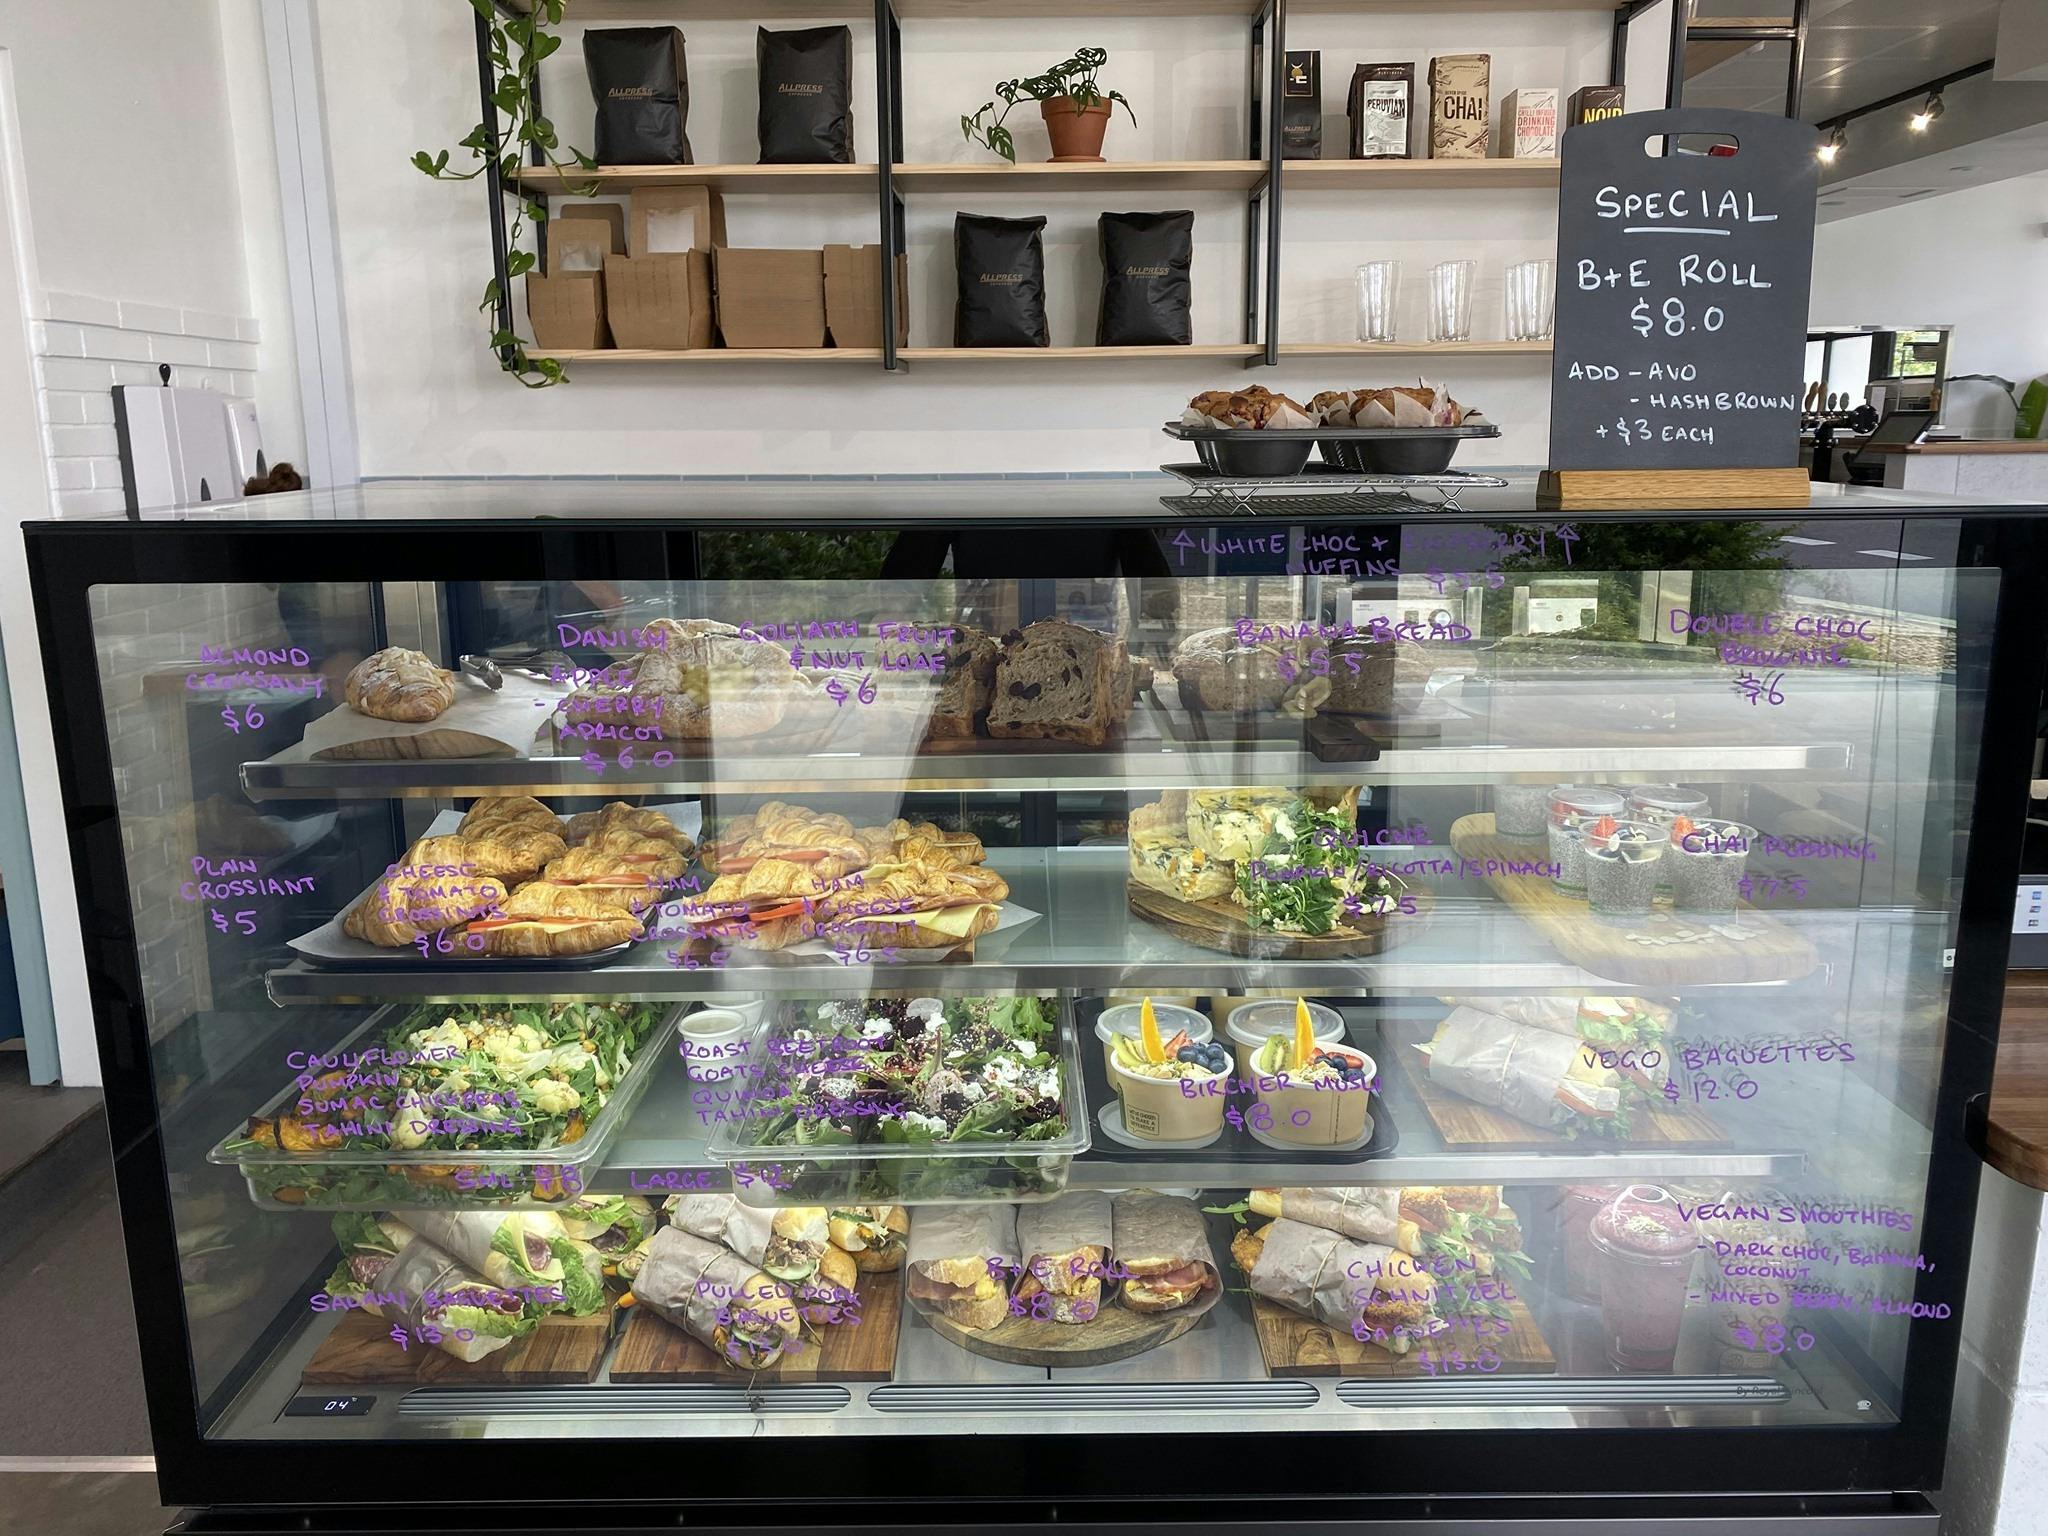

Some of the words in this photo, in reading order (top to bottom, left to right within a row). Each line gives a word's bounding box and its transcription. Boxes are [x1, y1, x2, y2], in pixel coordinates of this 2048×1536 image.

[608, 87, 654, 97] ALLPRESS
[778, 83, 823, 94] ALLPRESS
[1367, 98, 1405, 118] PERUVIAN
[1444, 96, 1483, 120] CHAI
[1517, 117, 1556, 126] DRINKING
[1517, 126, 1555, 137] CHOCOLATE
[1595, 186, 1778, 222] SPECIAL
[1577, 259, 1651, 290] B+E
[1679, 254, 1772, 288] ROLL
[1630, 297, 1725, 337] $8.0
[1568, 362, 1620, 380] ADD
[1648, 362, 1697, 381] AVO
[1616, 417, 1652, 445] $3
[1661, 426, 1714, 444] EACH
[1201, 533, 1285, 554] WHITE
[1296, 535, 1360, 552] CHOC
[1286, 557, 1400, 577] MUFFINS
[738, 620, 858, 645] GOLIATH
[877, 620, 956, 647] FRUIT
[1235, 616, 1358, 645] BANANA
[1368, 615, 1473, 643] BREAD
[1670, 609, 1782, 635] DOUBLE
[1794, 616, 1876, 642] CHOC
[557, 623, 668, 652] DANISH
[200, 643, 311, 666] ALMOND
[812, 649, 866, 670] NUT
[881, 650, 946, 673] LOAF
[549, 664, 638, 688] APPLE
[826, 673, 877, 707] $6
[1740, 672, 1785, 705] $6
[221, 704, 265, 734] $6
[557, 695, 665, 720] CHERRY
[560, 722, 663, 740] APRICOT
[1314, 826, 1433, 849] QUICHE
[1681, 832, 1748, 853] CHAI
[191, 856, 258, 877] PLAIN
[384, 863, 477, 880] CHEESE
[179, 877, 315, 901] CROSSIANT
[398, 885, 497, 900] TOMATO
[647, 875, 701, 892] HAM
[811, 874, 865, 890] HAM
[655, 902, 749, 917] TOMATO
[822, 897, 914, 916] CHEESE
[211, 908, 257, 935] $5
[679, 1039, 752, 1058] ROAST
[1583, 1050, 1661, 1071] VEGO
[1684, 1043, 1855, 1070] BAGUETTES
[295, 1072, 400, 1092] PUMPKIN
[687, 1063, 765, 1082] GOATS
[692, 1082, 792, 1105] QUINOA
[1179, 1073, 1295, 1098] BIRCHER
[1663, 1078, 1759, 1104] $12.0
[298, 1096, 385, 1116] SUMAC
[793, 1100, 908, 1120] DRESSING
[1225, 1102, 1312, 1132] $8.0
[302, 1119, 394, 1140] TAHINI
[1677, 1203, 1770, 1223] VEGAN
[1778, 1206, 1913, 1233] SMOOTHIES
[1714, 1241, 1774, 1257] DARK
[1070, 1256, 1141, 1281] ROLL
[1347, 1254, 1476, 1279] CHICKEN
[1724, 1264, 1810, 1280] COCONUT
[310, 1290, 407, 1313] SALAMI
[695, 1280, 793, 1300] PULLED
[803, 1286, 862, 1307] PORK
[1353, 1282, 1517, 1310] SCHNITZEL
[1711, 1290, 1780, 1305] MIXED
[1870, 1295, 1951, 1320] ALMOND
